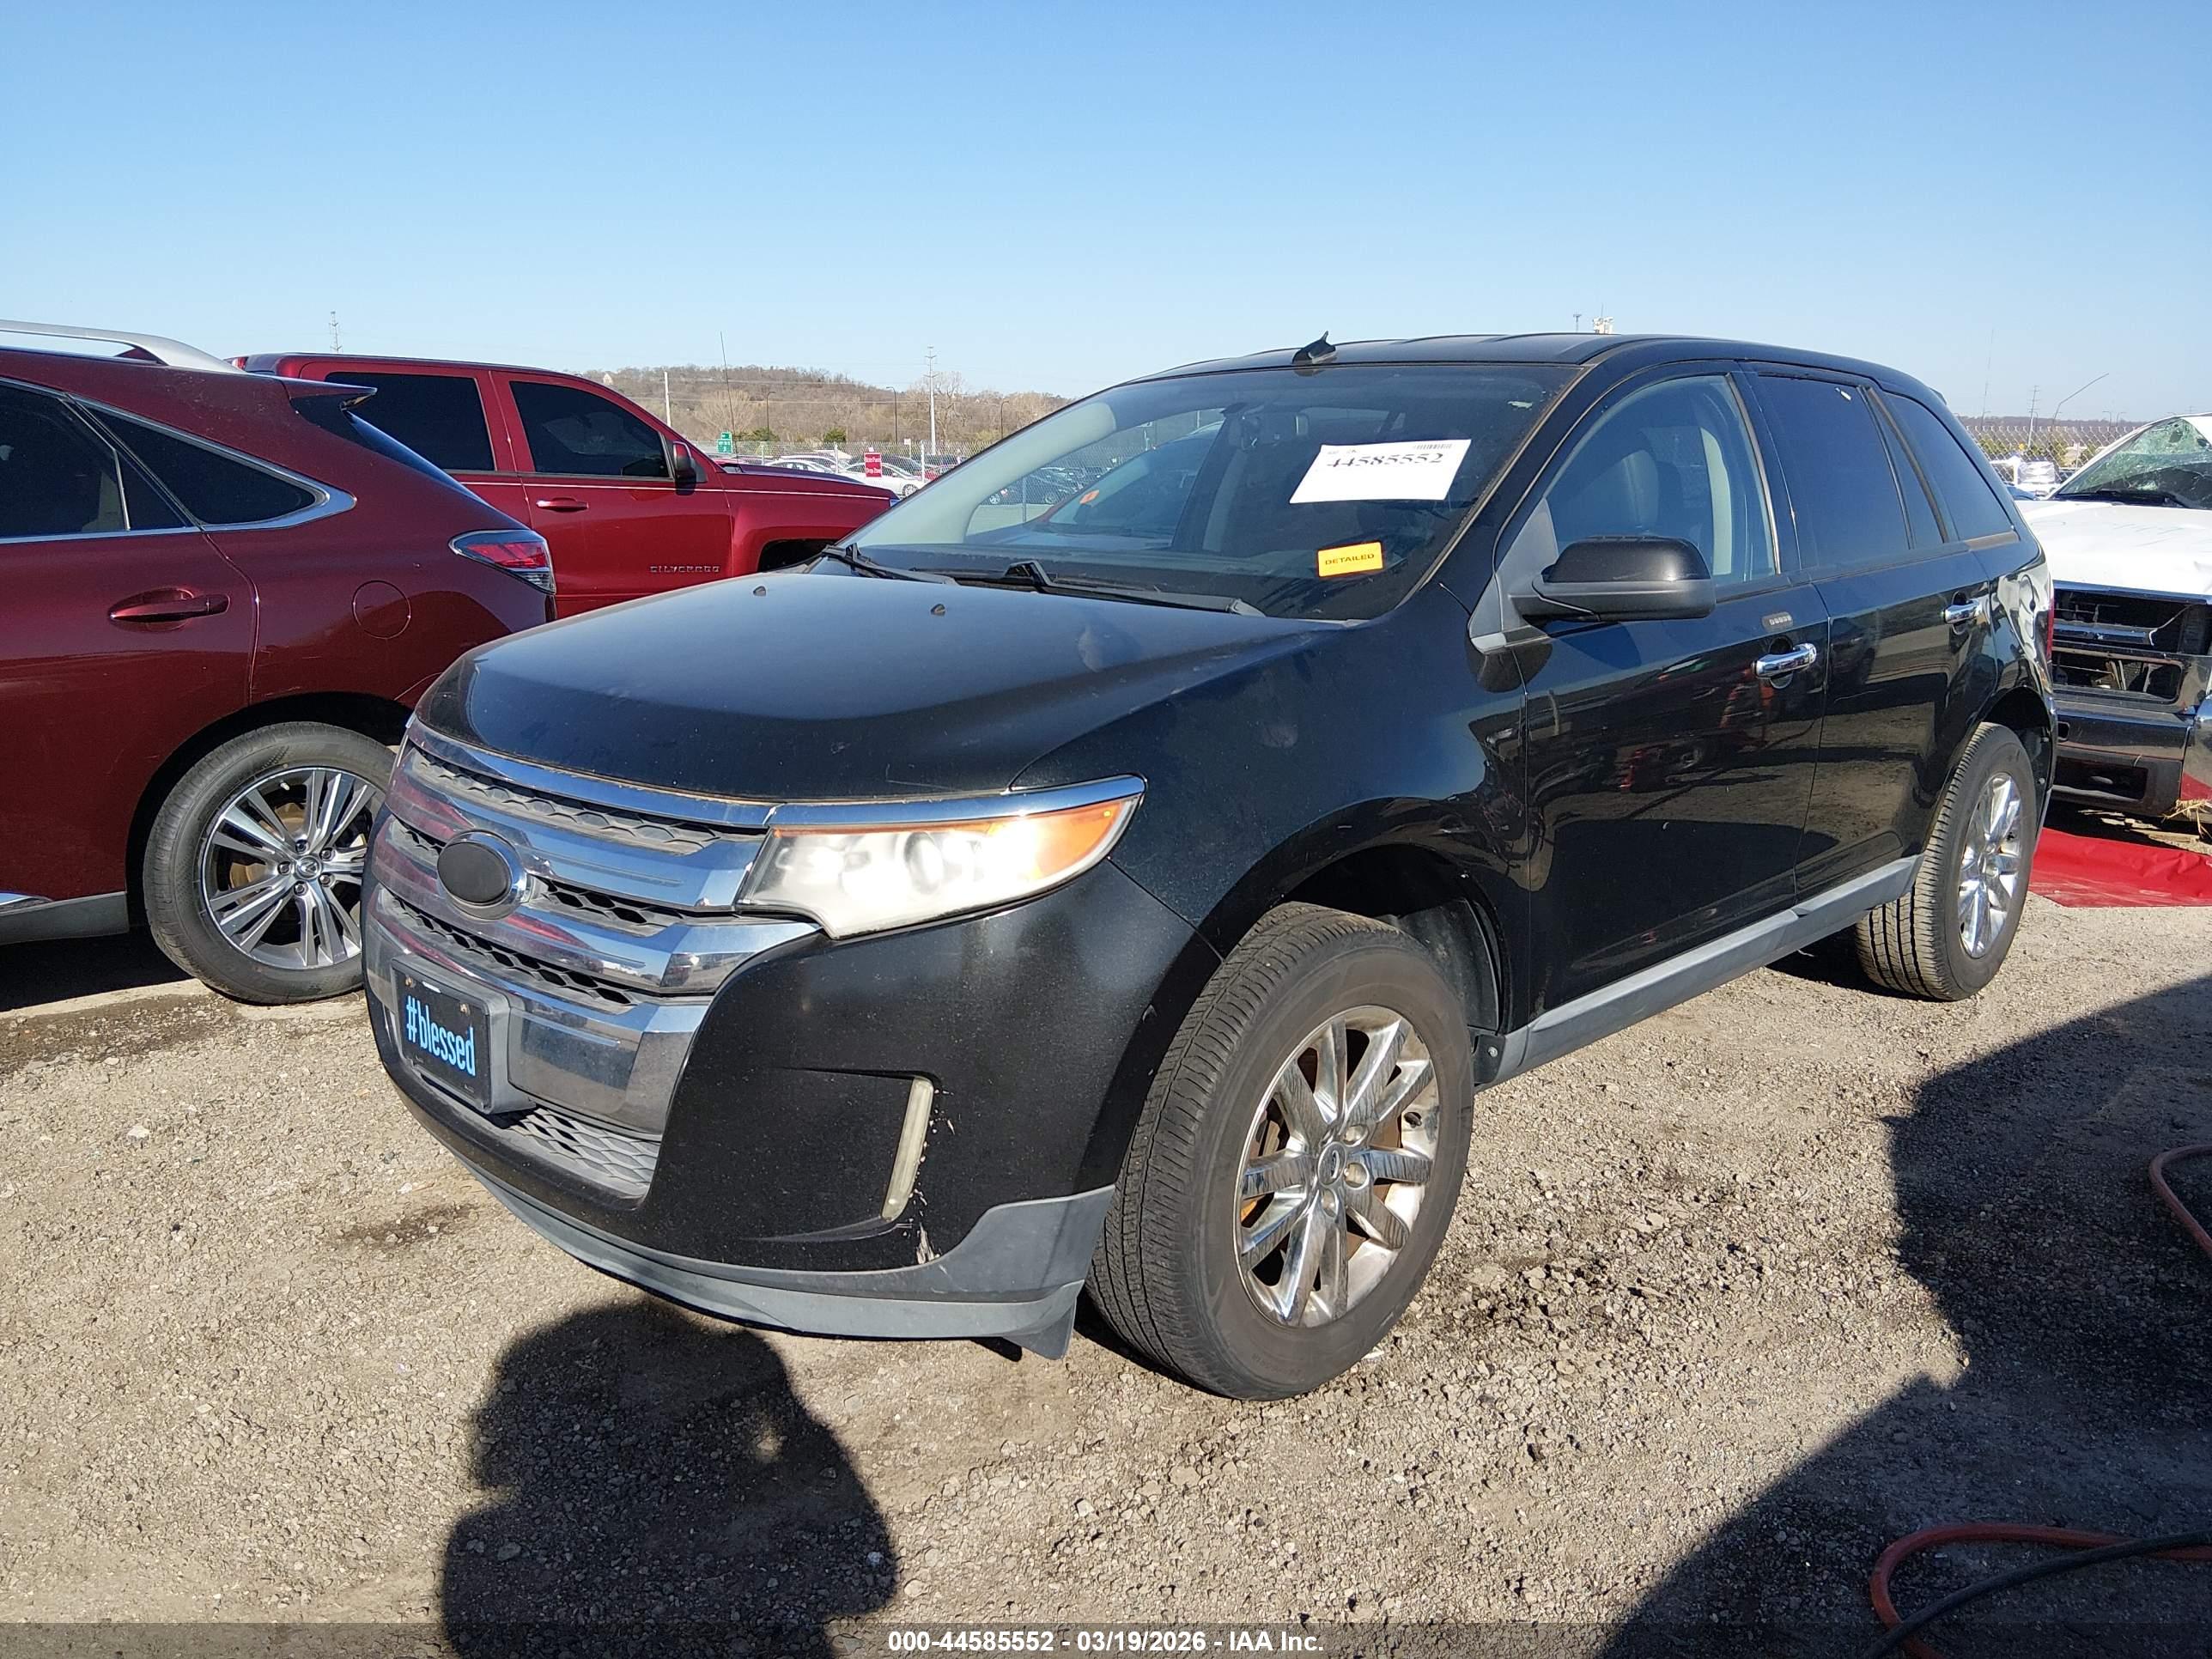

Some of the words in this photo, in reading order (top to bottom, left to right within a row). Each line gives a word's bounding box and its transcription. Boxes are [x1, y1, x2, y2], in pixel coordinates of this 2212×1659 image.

[1327, 453, 1443, 467] 44585552
[1325, 553, 1375, 565] DETAILED
[406, 995, 476, 1077] #blessed
